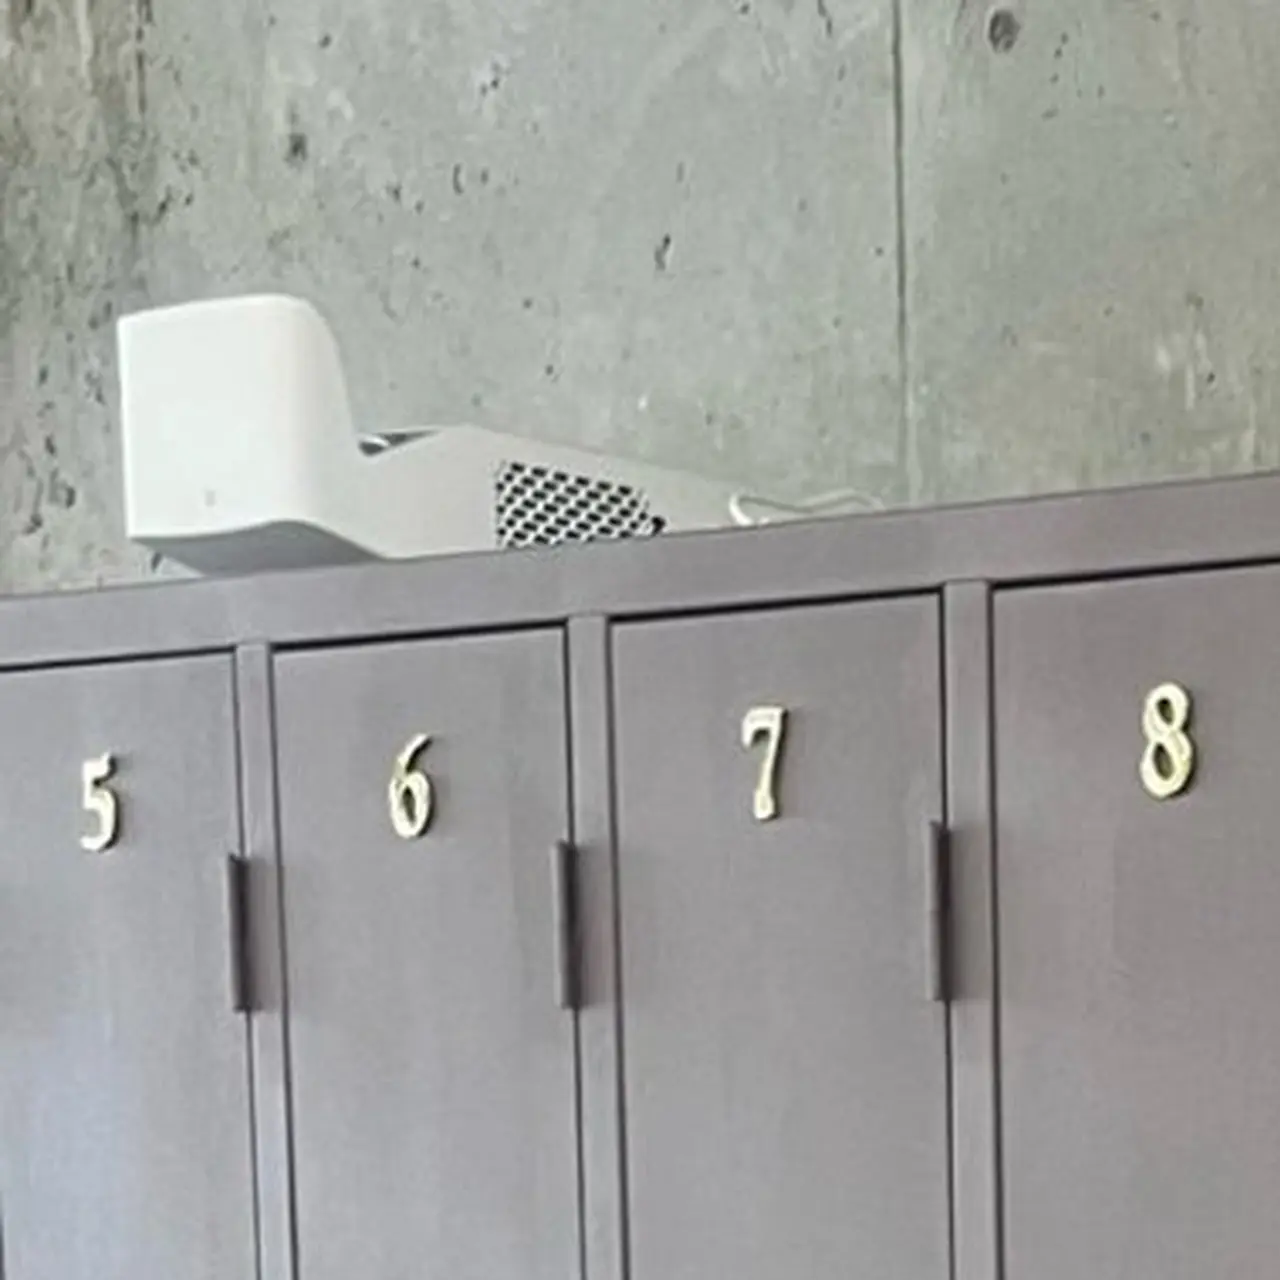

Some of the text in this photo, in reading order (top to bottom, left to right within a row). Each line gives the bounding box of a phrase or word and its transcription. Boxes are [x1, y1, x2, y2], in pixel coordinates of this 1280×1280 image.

[388, 732, 434, 840] 6
[741, 705, 789, 821] 7
[1139, 682, 1195, 799] 8
[79, 751, 119, 852] 5
